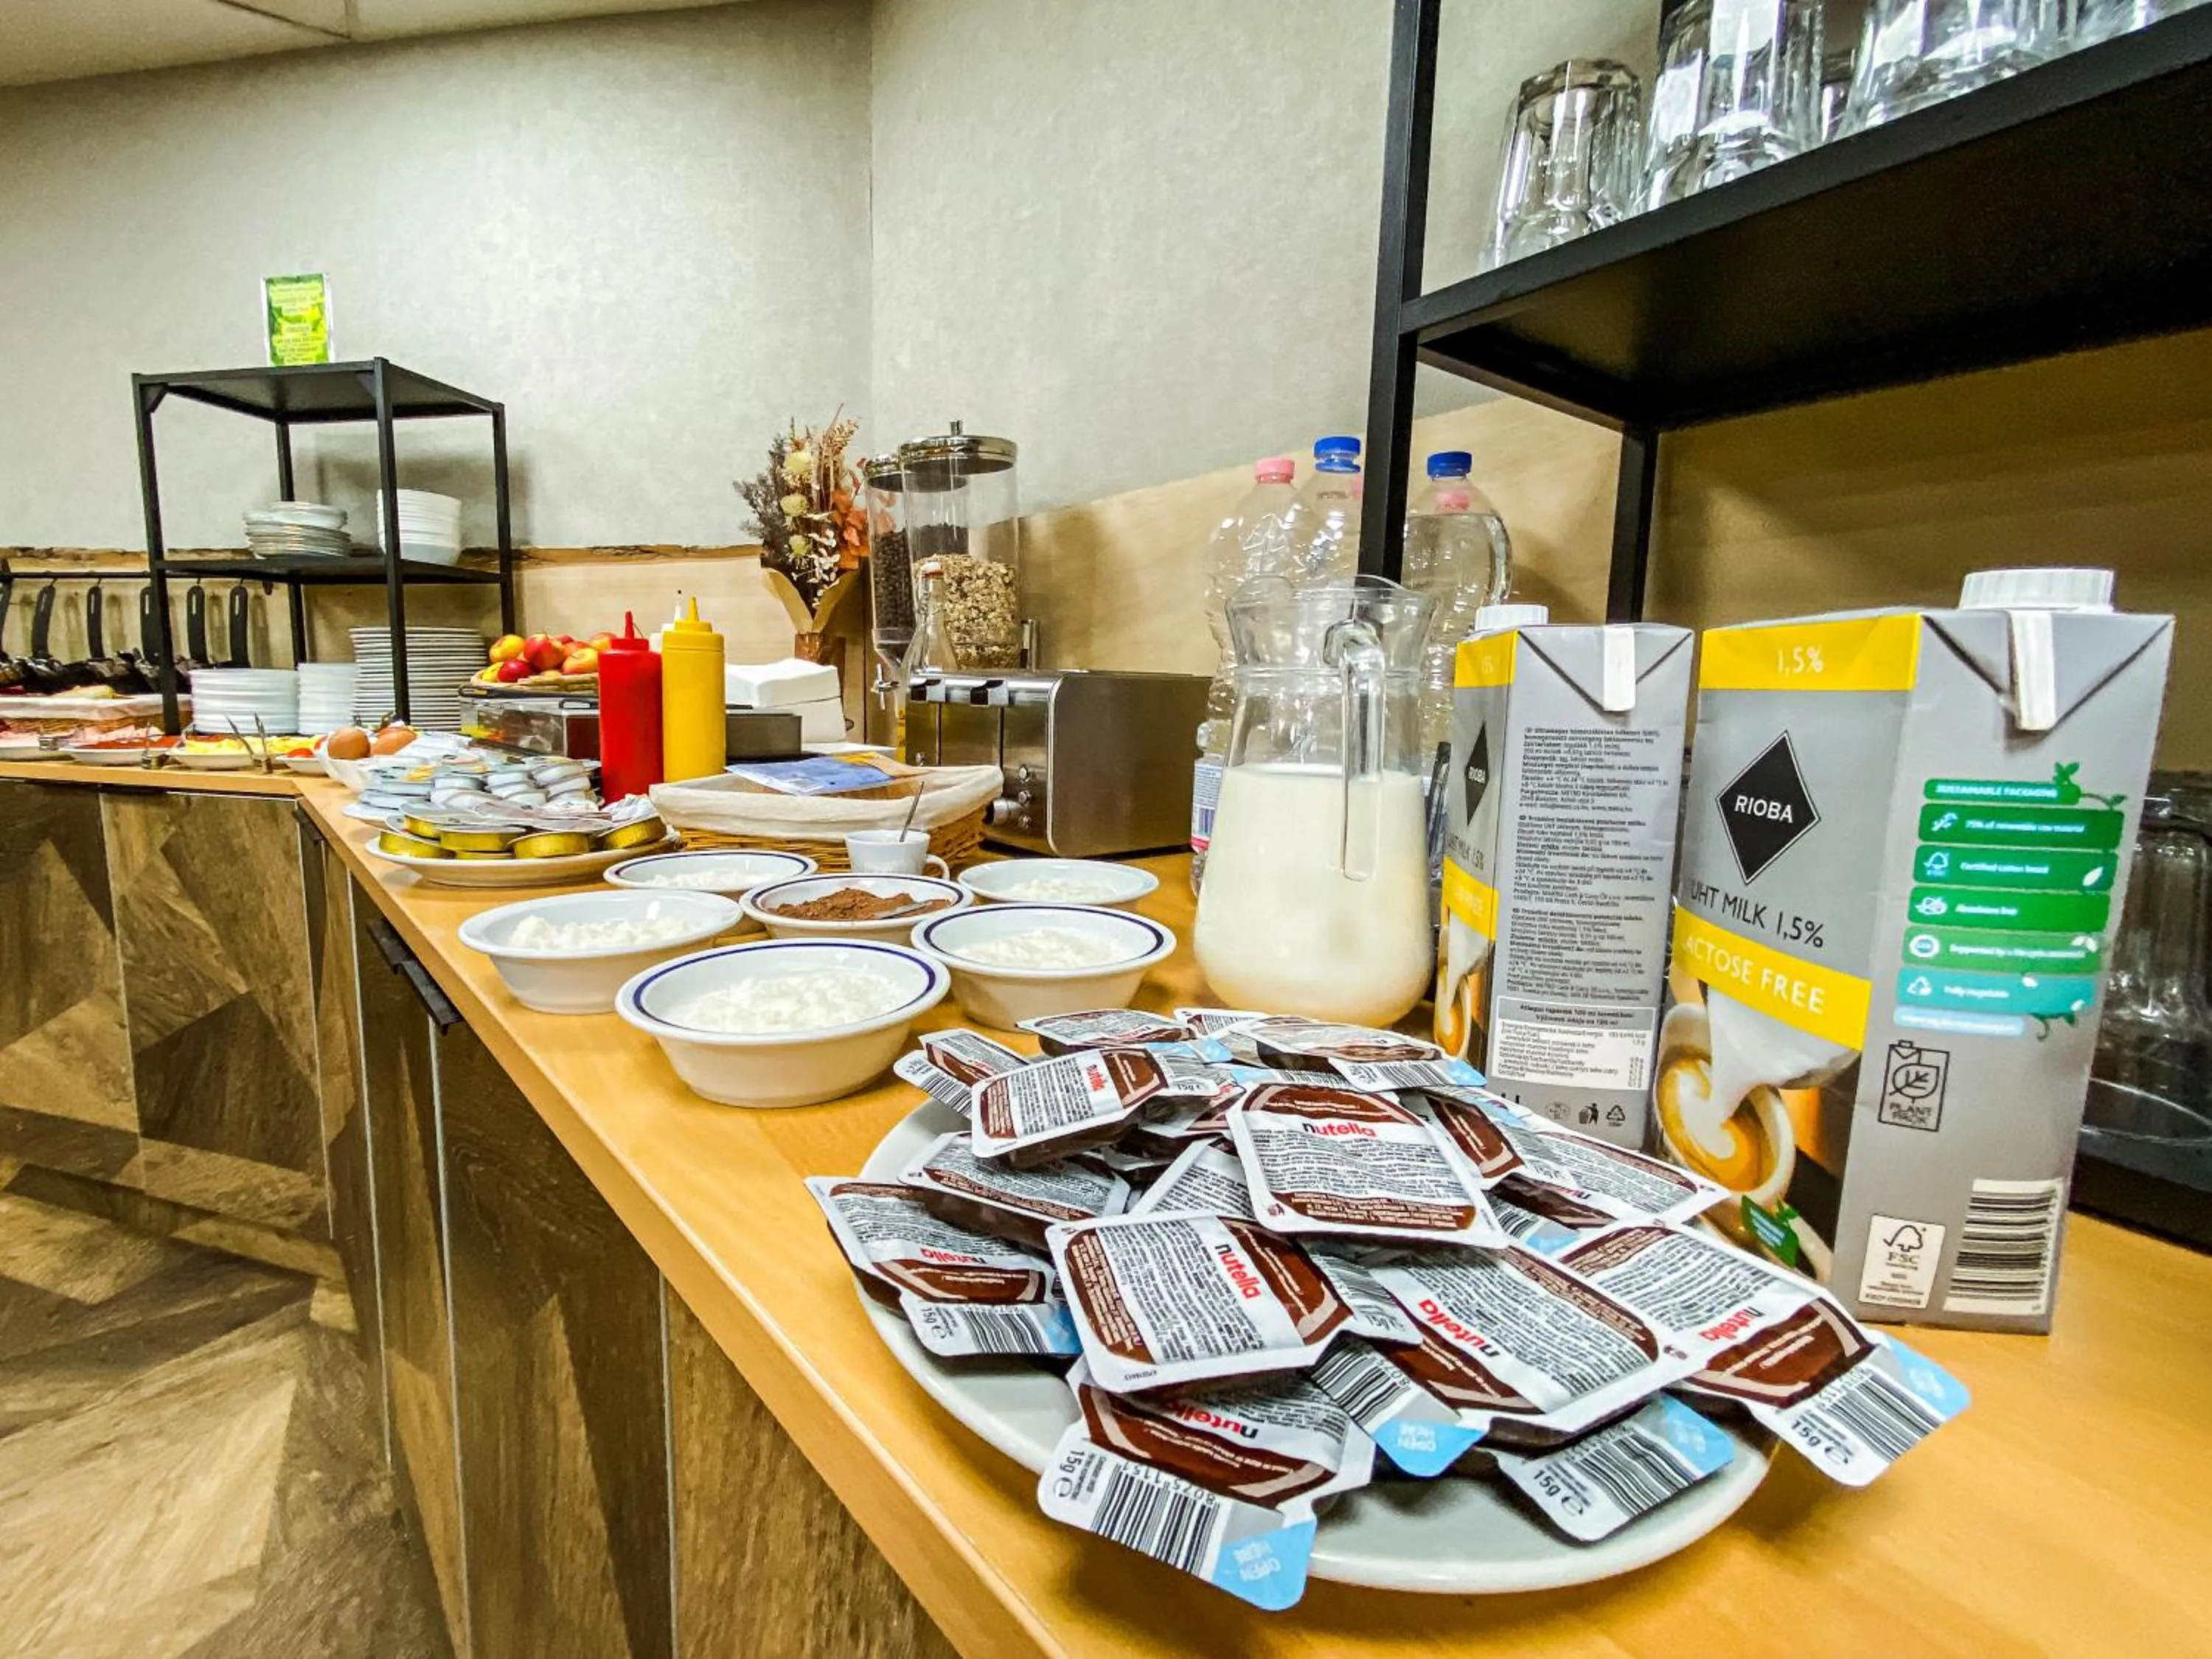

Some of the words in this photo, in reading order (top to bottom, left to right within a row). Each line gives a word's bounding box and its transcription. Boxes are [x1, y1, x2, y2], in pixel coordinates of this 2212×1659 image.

[1734, 795, 1793, 824] RIOBA
[1691, 880, 1720, 909] UHT
[1722, 892, 1767, 929] MILK
[1776, 911, 1824, 948] 1,5%
[1684, 933, 1754, 985] ACTOSE
[1760, 967, 1826, 1015] FREE
[1889, 1102, 1933, 1117] PLANT
[1302, 1121, 1377, 1138] nutella
[920, 1247, 987, 1265] nutella
[1888, 1251, 1921, 1265] FSC
[1214, 1242, 1262, 1300] nutella
[1419, 1298, 1500, 1358] nutella
[1700, 1307, 1764, 1343] nutella
[1791, 1420, 1822, 1448] 15g
[1060, 1449, 1085, 1475] 15g
[1533, 1469, 1562, 1497] 15g
